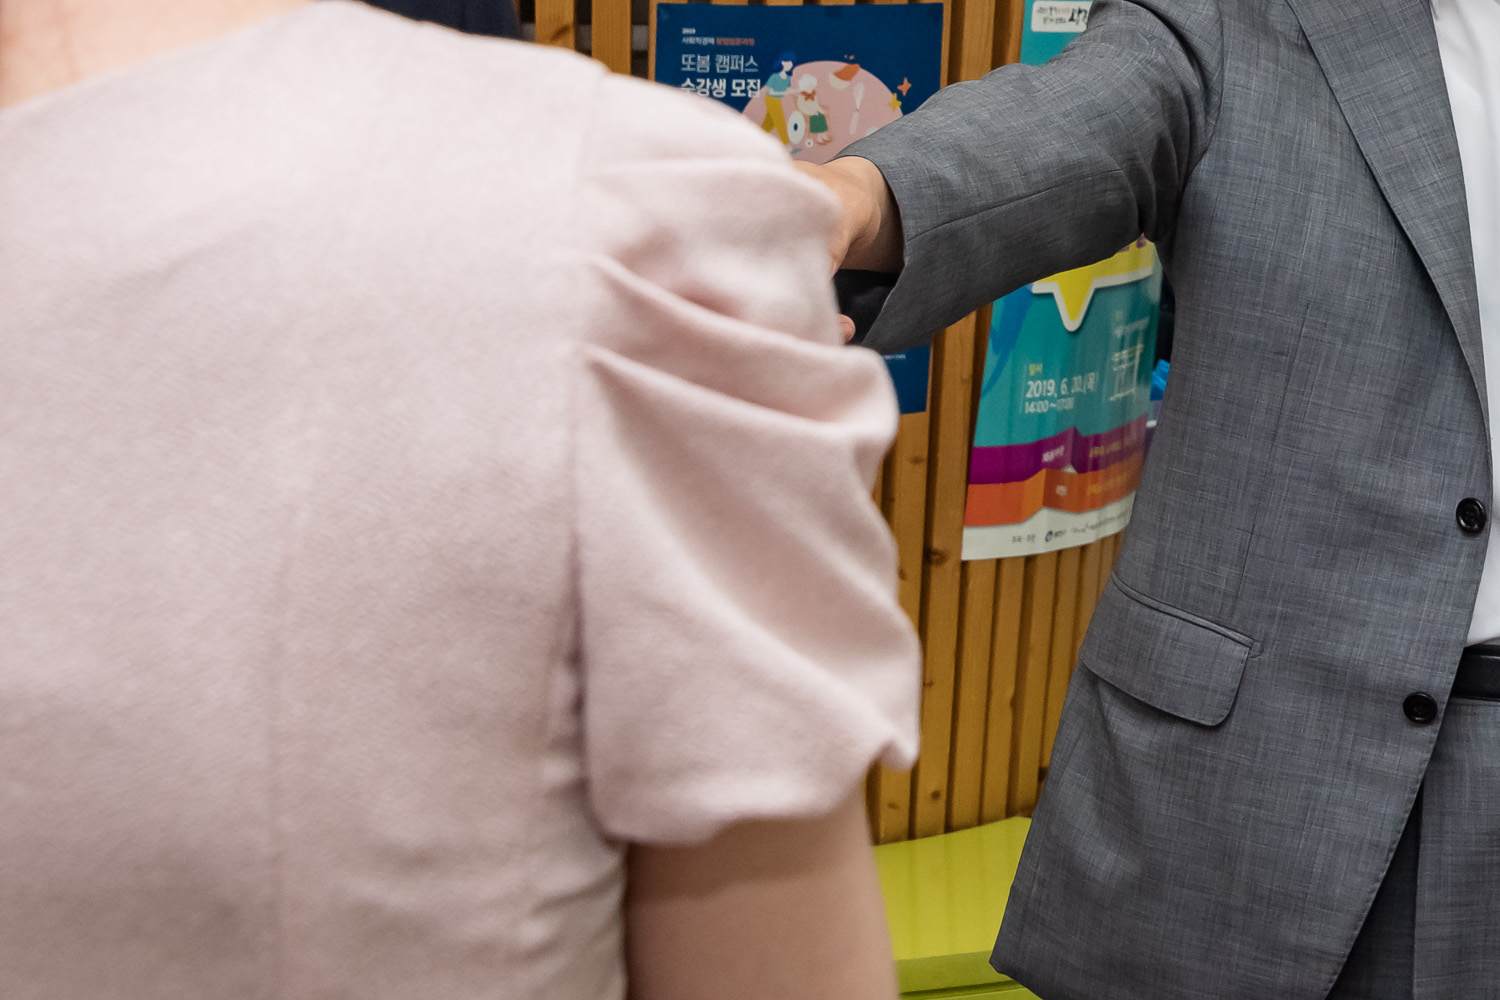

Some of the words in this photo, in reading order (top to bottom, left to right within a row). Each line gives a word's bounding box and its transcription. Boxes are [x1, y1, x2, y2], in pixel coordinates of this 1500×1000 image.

[681, 54, 710, 73] 또봄
[715, 54, 758, 73] 캠퍼스
[681, 77, 727, 98] 수강생
[731, 78, 761, 98] 모집
